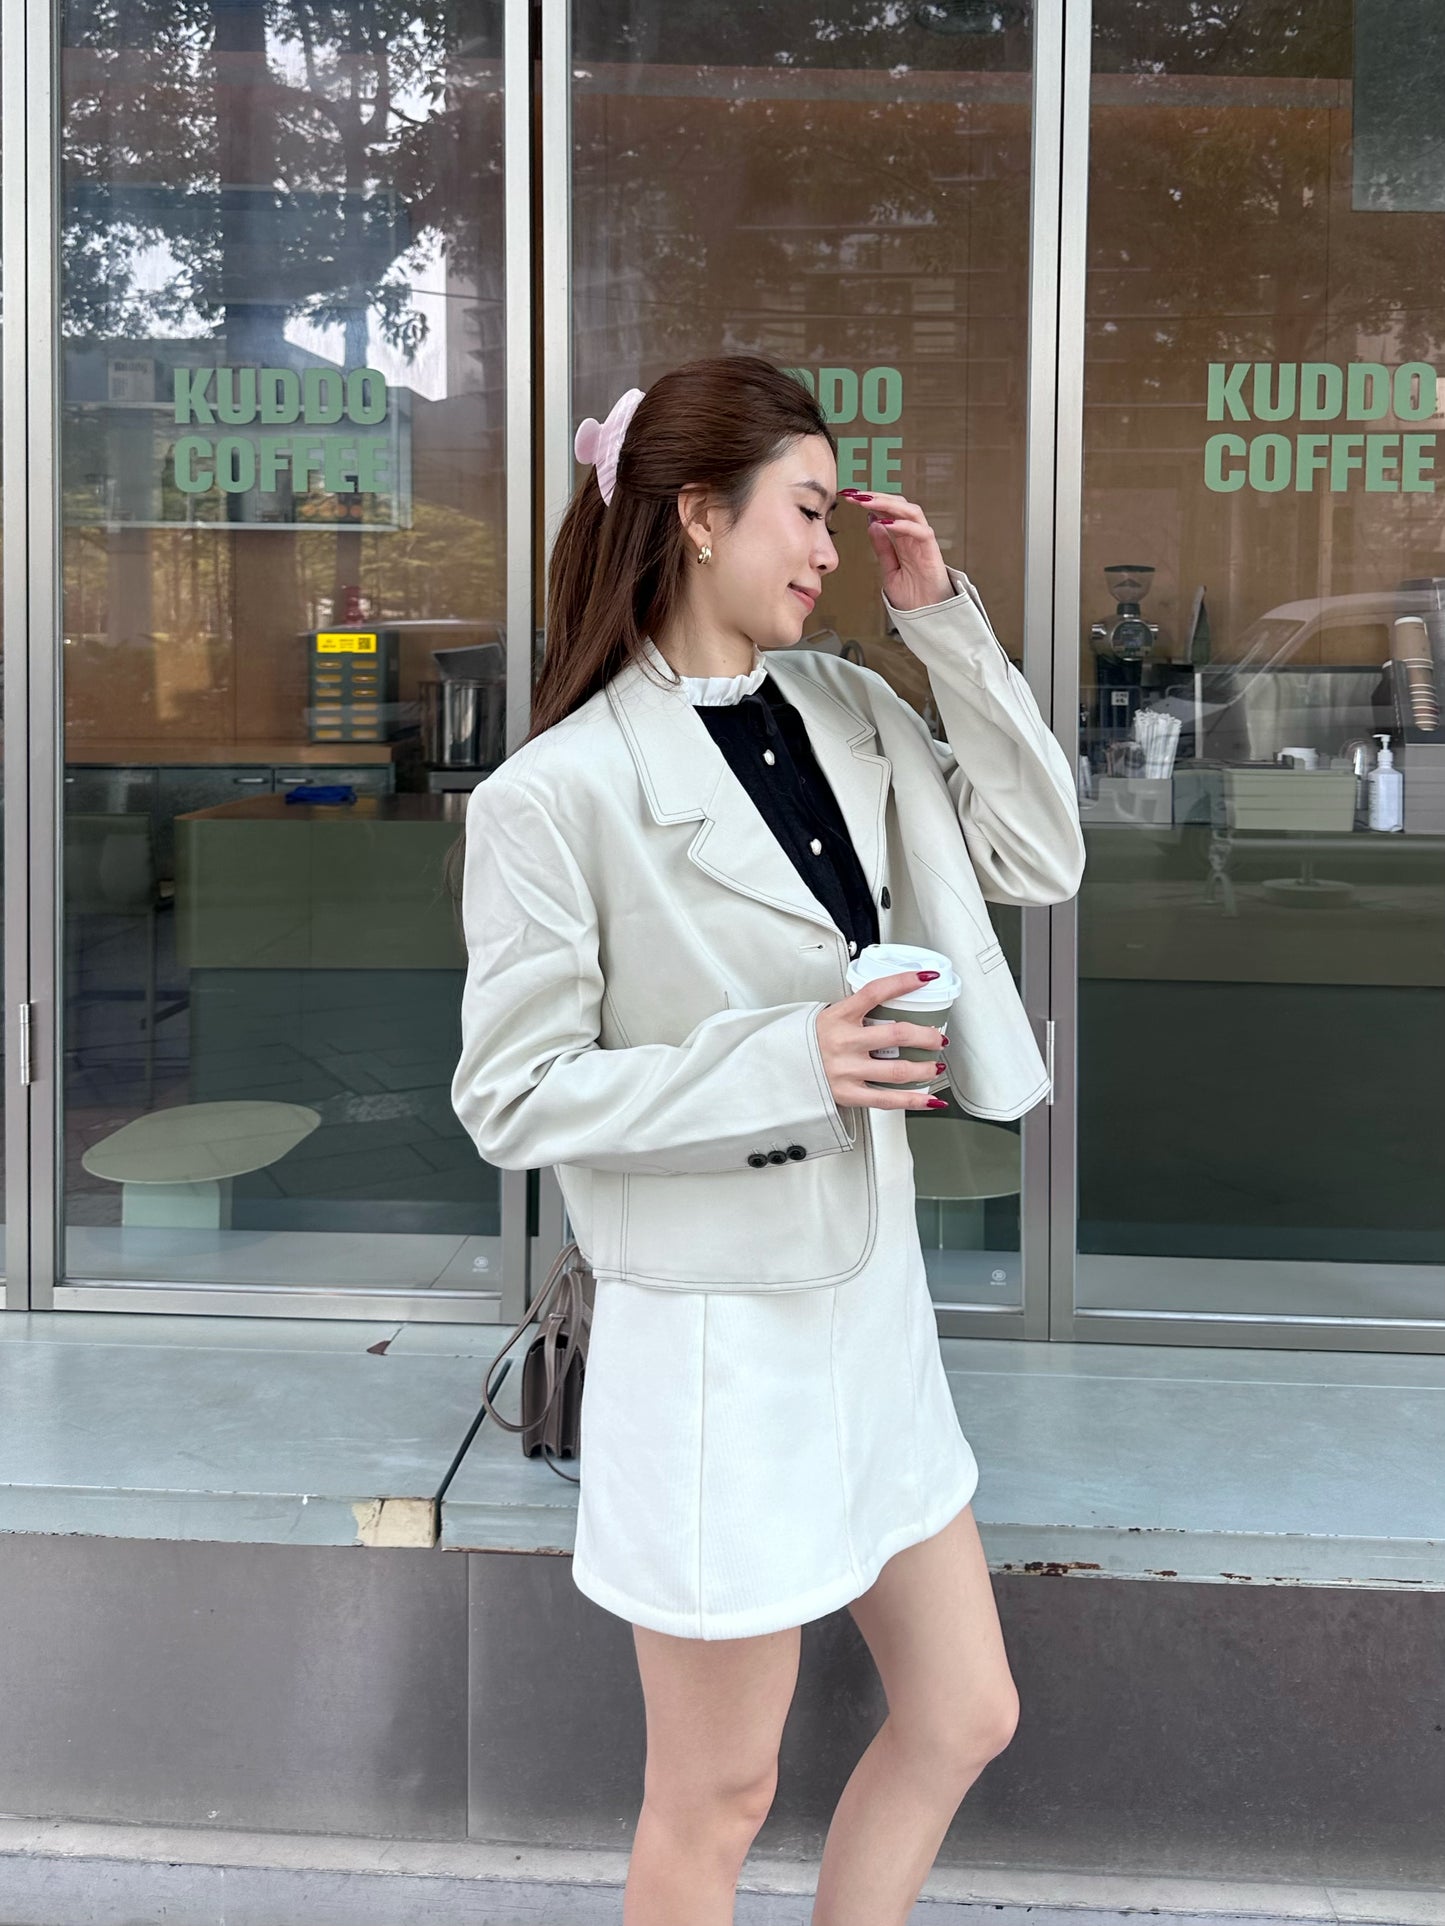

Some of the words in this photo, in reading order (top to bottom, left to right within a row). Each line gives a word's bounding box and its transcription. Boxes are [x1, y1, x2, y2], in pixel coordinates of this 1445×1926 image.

[174, 367, 388, 425] KUDDO
[1206, 361, 1438, 421] KUDDO
[173, 435, 390, 493] COFFEE
[1204, 433, 1437, 493] COFFEE
